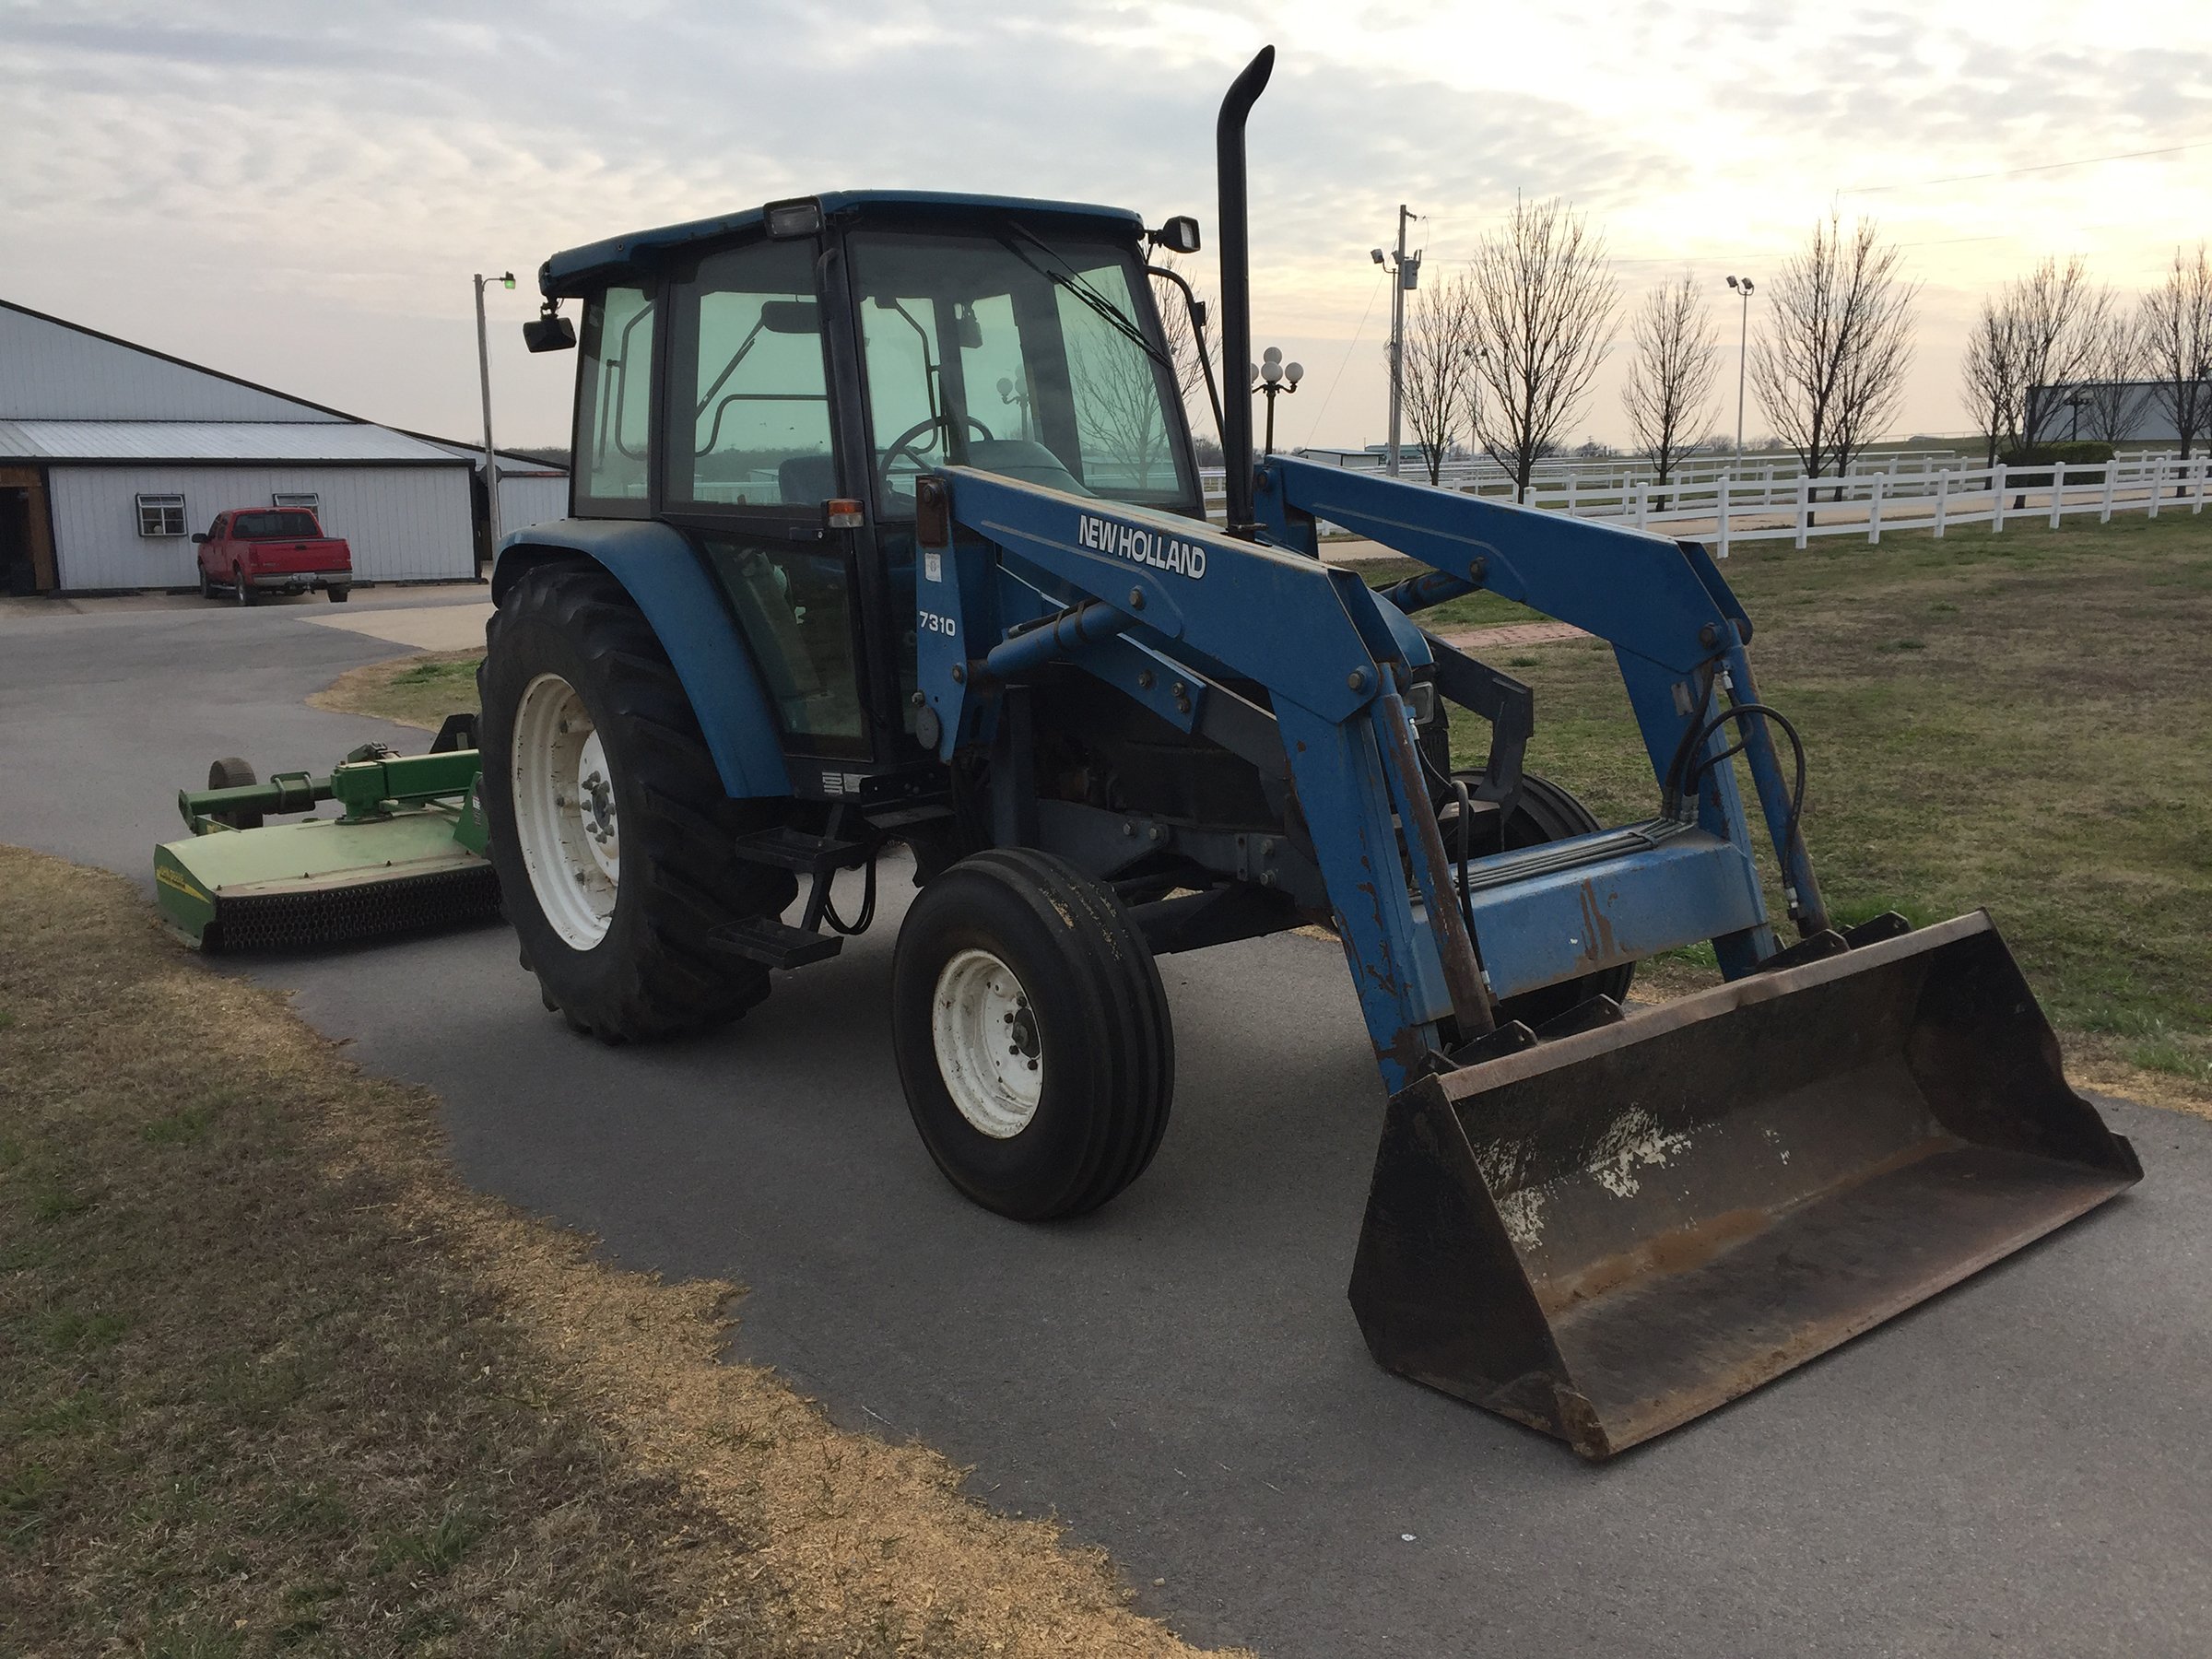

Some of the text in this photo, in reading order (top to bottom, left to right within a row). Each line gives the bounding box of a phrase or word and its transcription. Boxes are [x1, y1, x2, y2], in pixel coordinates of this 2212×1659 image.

[1078, 514, 1206, 580] NEW HOLLAND
[919, 610, 956, 637] 7310
